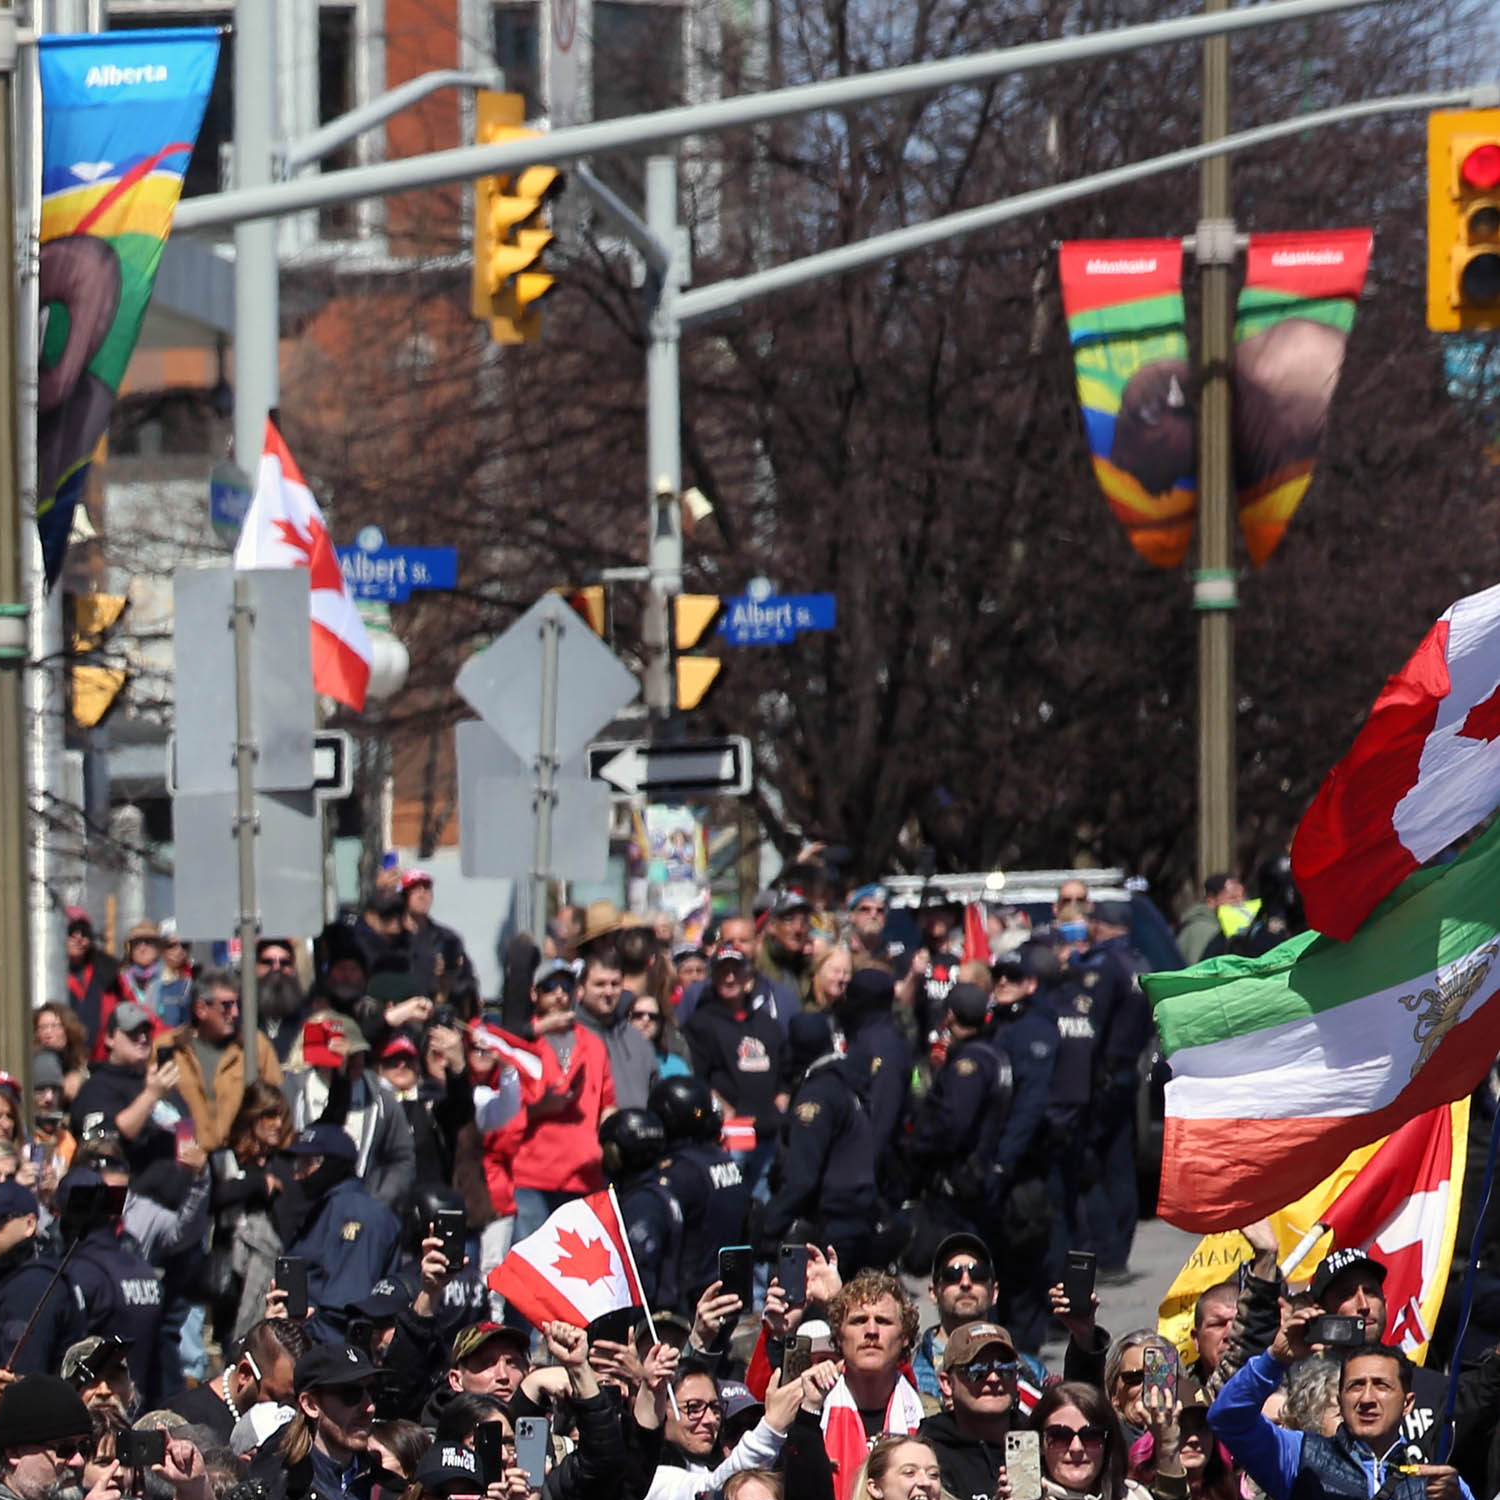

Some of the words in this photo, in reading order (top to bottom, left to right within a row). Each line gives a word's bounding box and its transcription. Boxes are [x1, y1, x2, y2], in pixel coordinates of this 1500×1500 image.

[86, 63, 168, 88] Alberta
[341, 551, 407, 584] Albert
[733, 601, 793, 628] Albert
[120, 1279, 160, 1306] POLICE
[442, 1447, 456, 1457] WE
